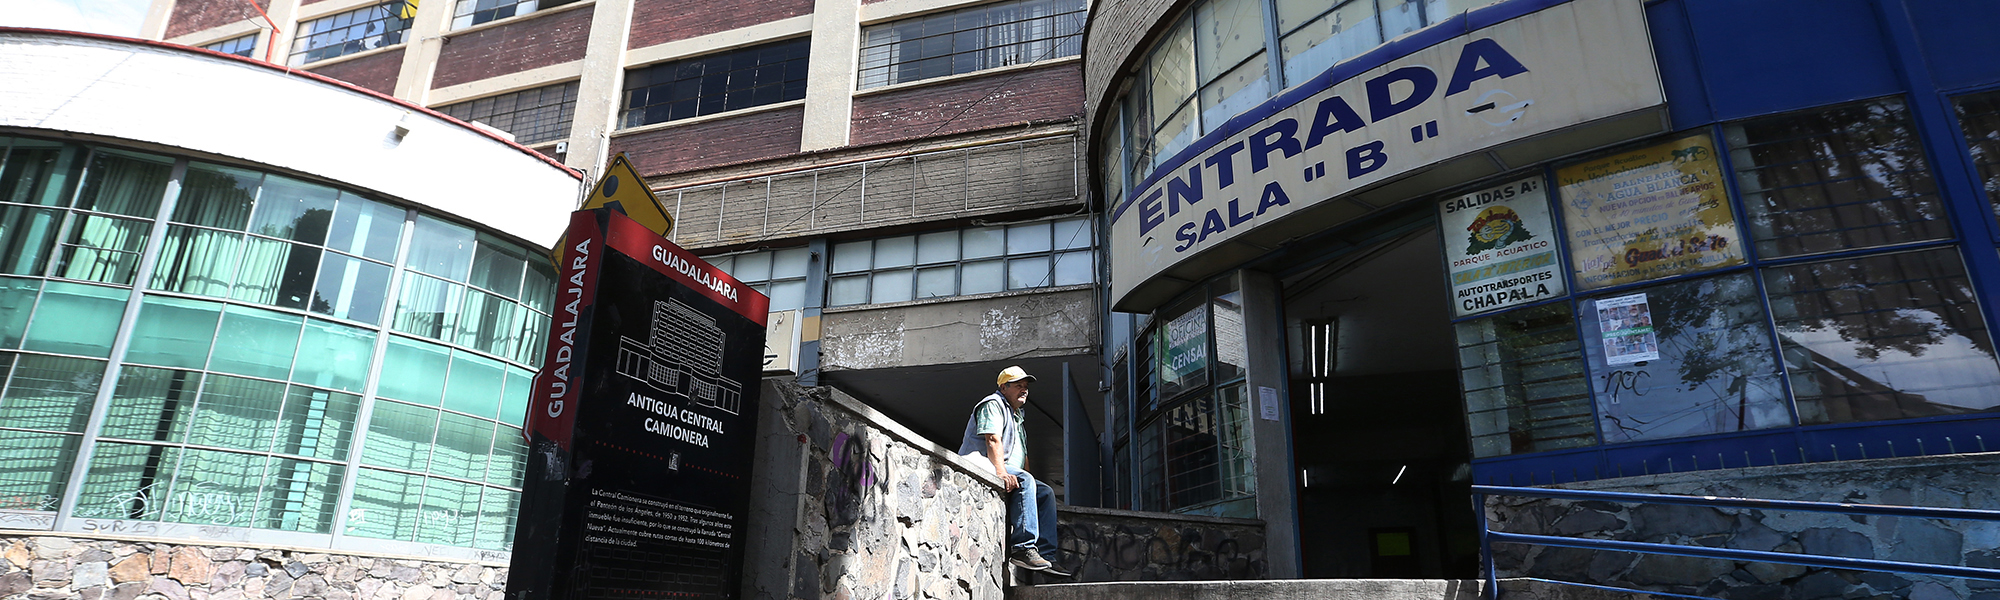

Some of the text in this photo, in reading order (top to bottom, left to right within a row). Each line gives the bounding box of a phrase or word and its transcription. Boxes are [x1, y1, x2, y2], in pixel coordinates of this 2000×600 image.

[1138, 38, 1530, 237] ENTRADA
[1583, 162, 1610, 173] Parque
[1614, 169, 1681, 190] BALNEARIO
[1445, 180, 1538, 213] SALIDAS A:
[1599, 201, 1628, 213] NUEVA
[1630, 194, 1657, 206] OPCION
[1631, 204, 1663, 215] minutos
[1175, 181, 1291, 253] SALA
[1576, 229, 1592, 238] CON
[1594, 227, 1604, 235] EL
[1606, 221, 1631, 231] MEJOR
[1633, 212, 1669, 225] PRECIO
[1670, 219, 1705, 231] vuelta
[1454, 240, 1548, 267] PARQUE ACUATICO
[652, 244, 738, 302] GUADALAJARA
[1455, 269, 1480, 285] SALA
[1497, 252, 1552, 275] INTERIOR
[1584, 268, 1641, 284] INFORMACION
[1655, 262, 1679, 272] SALA
[1458, 271, 1553, 298] AUTOTRANSPORTES
[1463, 283, 1550, 311] CHAPALA
[547, 238, 592, 418] GUADALAJARA
[627, 392, 724, 434] ANTIGUA CENTRAL
[644, 417, 709, 448] CAMIONERA
[592, 488, 598, 496] La
[599, 489, 617, 499] Central
[617, 492, 642, 504] Camionera
[679, 505, 694, 513] terreno
[702, 509, 726, 519] originalmente
[618, 504, 625, 512] de
[626, 505, 634, 513] los
[655, 510, 661, 518] de
[690, 516, 698, 524] Tras
[699, 518, 714, 527] algunos
[588, 511, 612, 521] inmueble
[613, 514, 621, 522] fue
[701, 528, 716, 537] llamada
[607, 526, 638, 536] Actualmente
[638, 530, 652, 538] cubre
[685, 536, 696, 544] hasta
[585, 534, 608, 544] distancia
